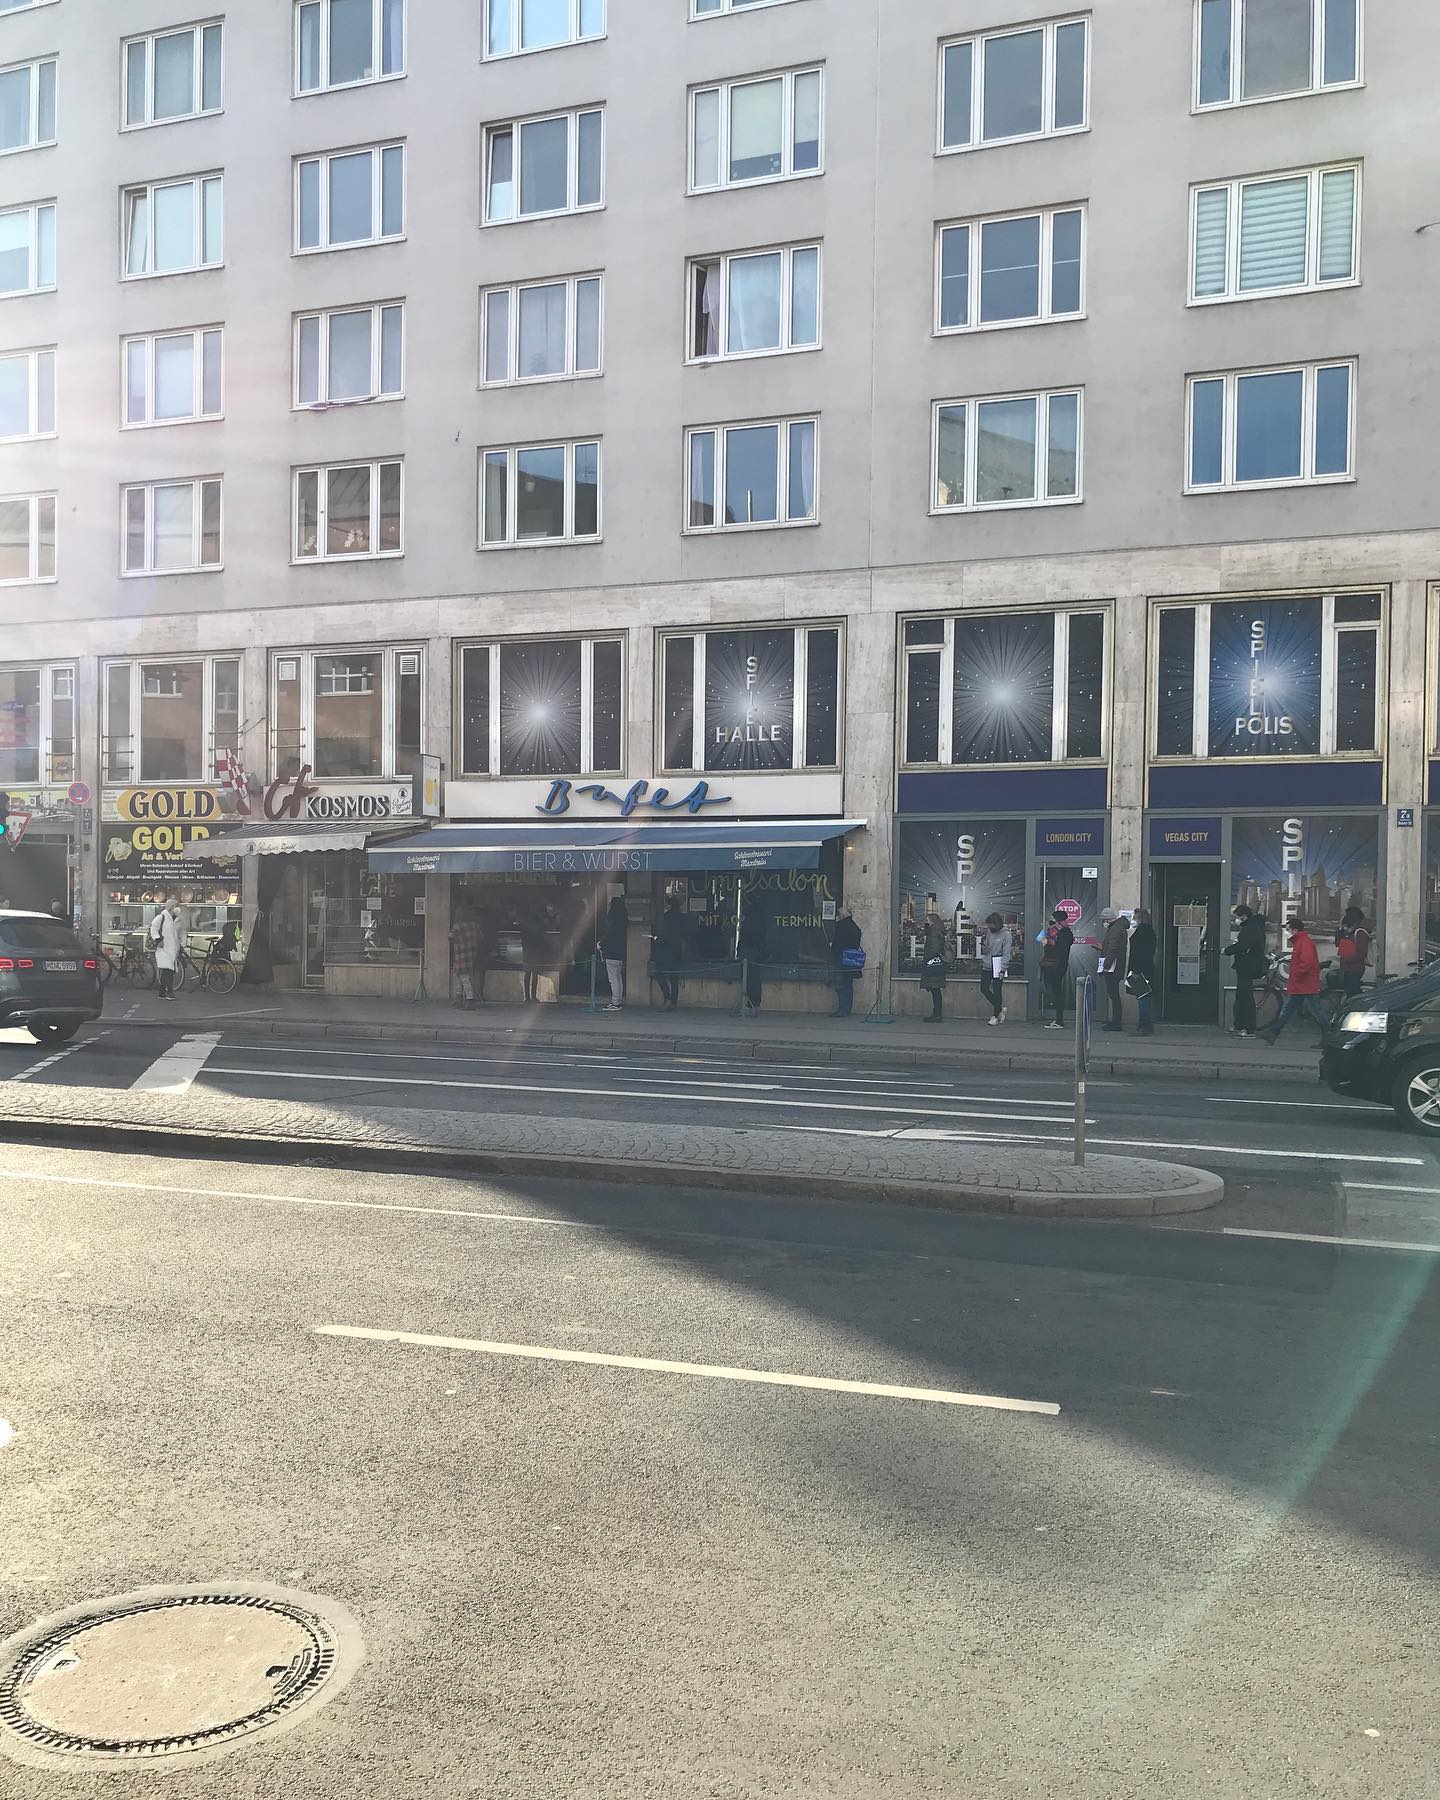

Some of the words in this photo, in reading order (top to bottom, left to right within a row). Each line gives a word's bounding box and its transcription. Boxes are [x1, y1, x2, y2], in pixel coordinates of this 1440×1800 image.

[716, 725, 782, 742] HALLE
[1235, 716, 1293, 735] POLIS
[129, 790, 215, 818] GOLD
[305, 796, 388, 818] KOSMOS
[1046, 833, 1075, 843] LONDON
[1075, 833, 1092, 841] CITY
[1164, 832, 1190, 842] VEGAS
[1191, 832, 1209, 841] CITY
[514, 852, 556, 871] BIER
[562, 852, 576, 870] &
[582, 851, 653, 870] WURST
[774, 913, 822, 928] TERMIN
